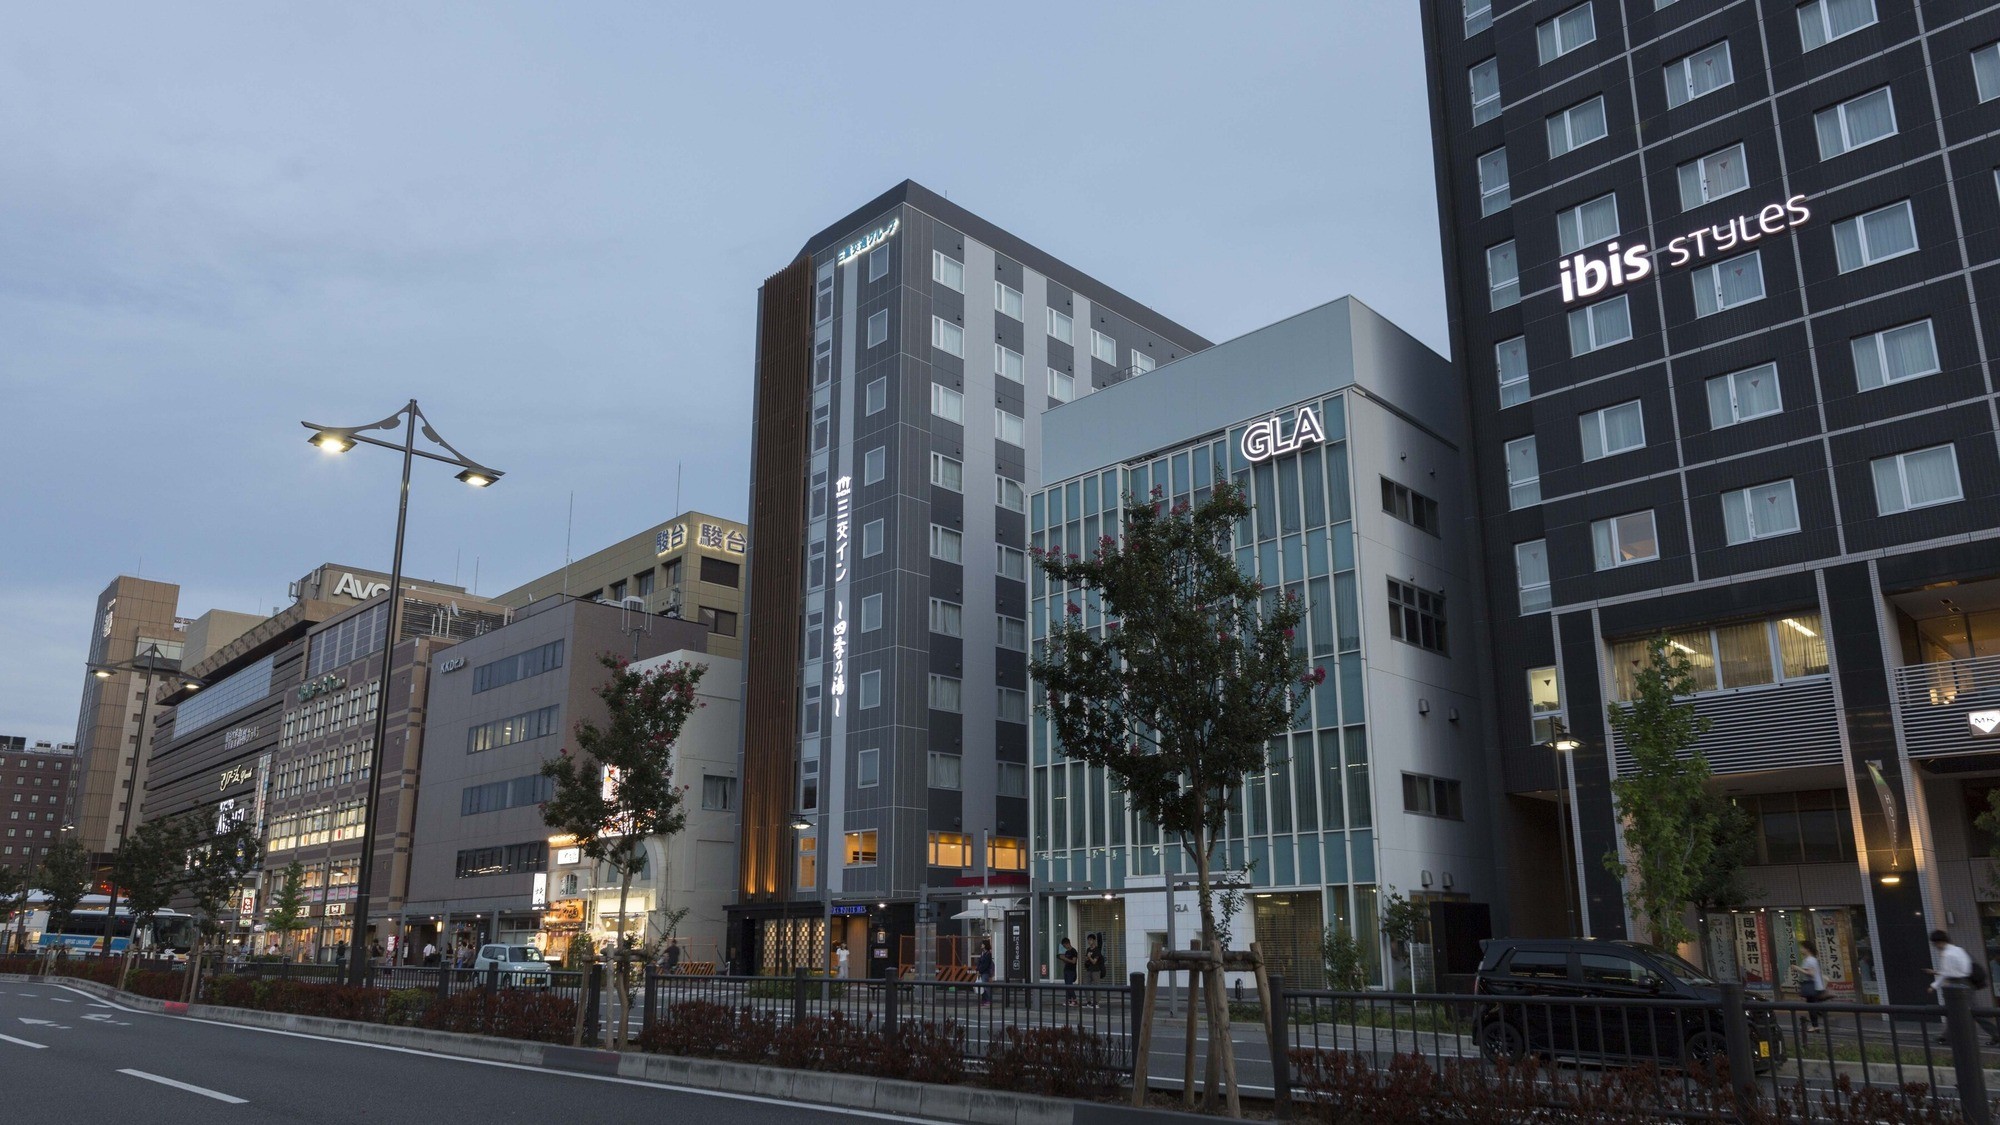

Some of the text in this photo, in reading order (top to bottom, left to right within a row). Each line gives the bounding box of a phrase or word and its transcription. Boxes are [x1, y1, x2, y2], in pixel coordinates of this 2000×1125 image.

[1559, 242, 1652, 303] ibis
[1241, 407, 1325, 461] GLA
[656, 523, 686, 556] 駿台
[700, 523, 747, 554] 駿台
[836, 498, 849, 582] 三交イン
[1974, 716, 1996, 725] MK
[1743, 917, 1759, 965] 団体旅行
[1825, 928, 1842, 979] MKトラベル
